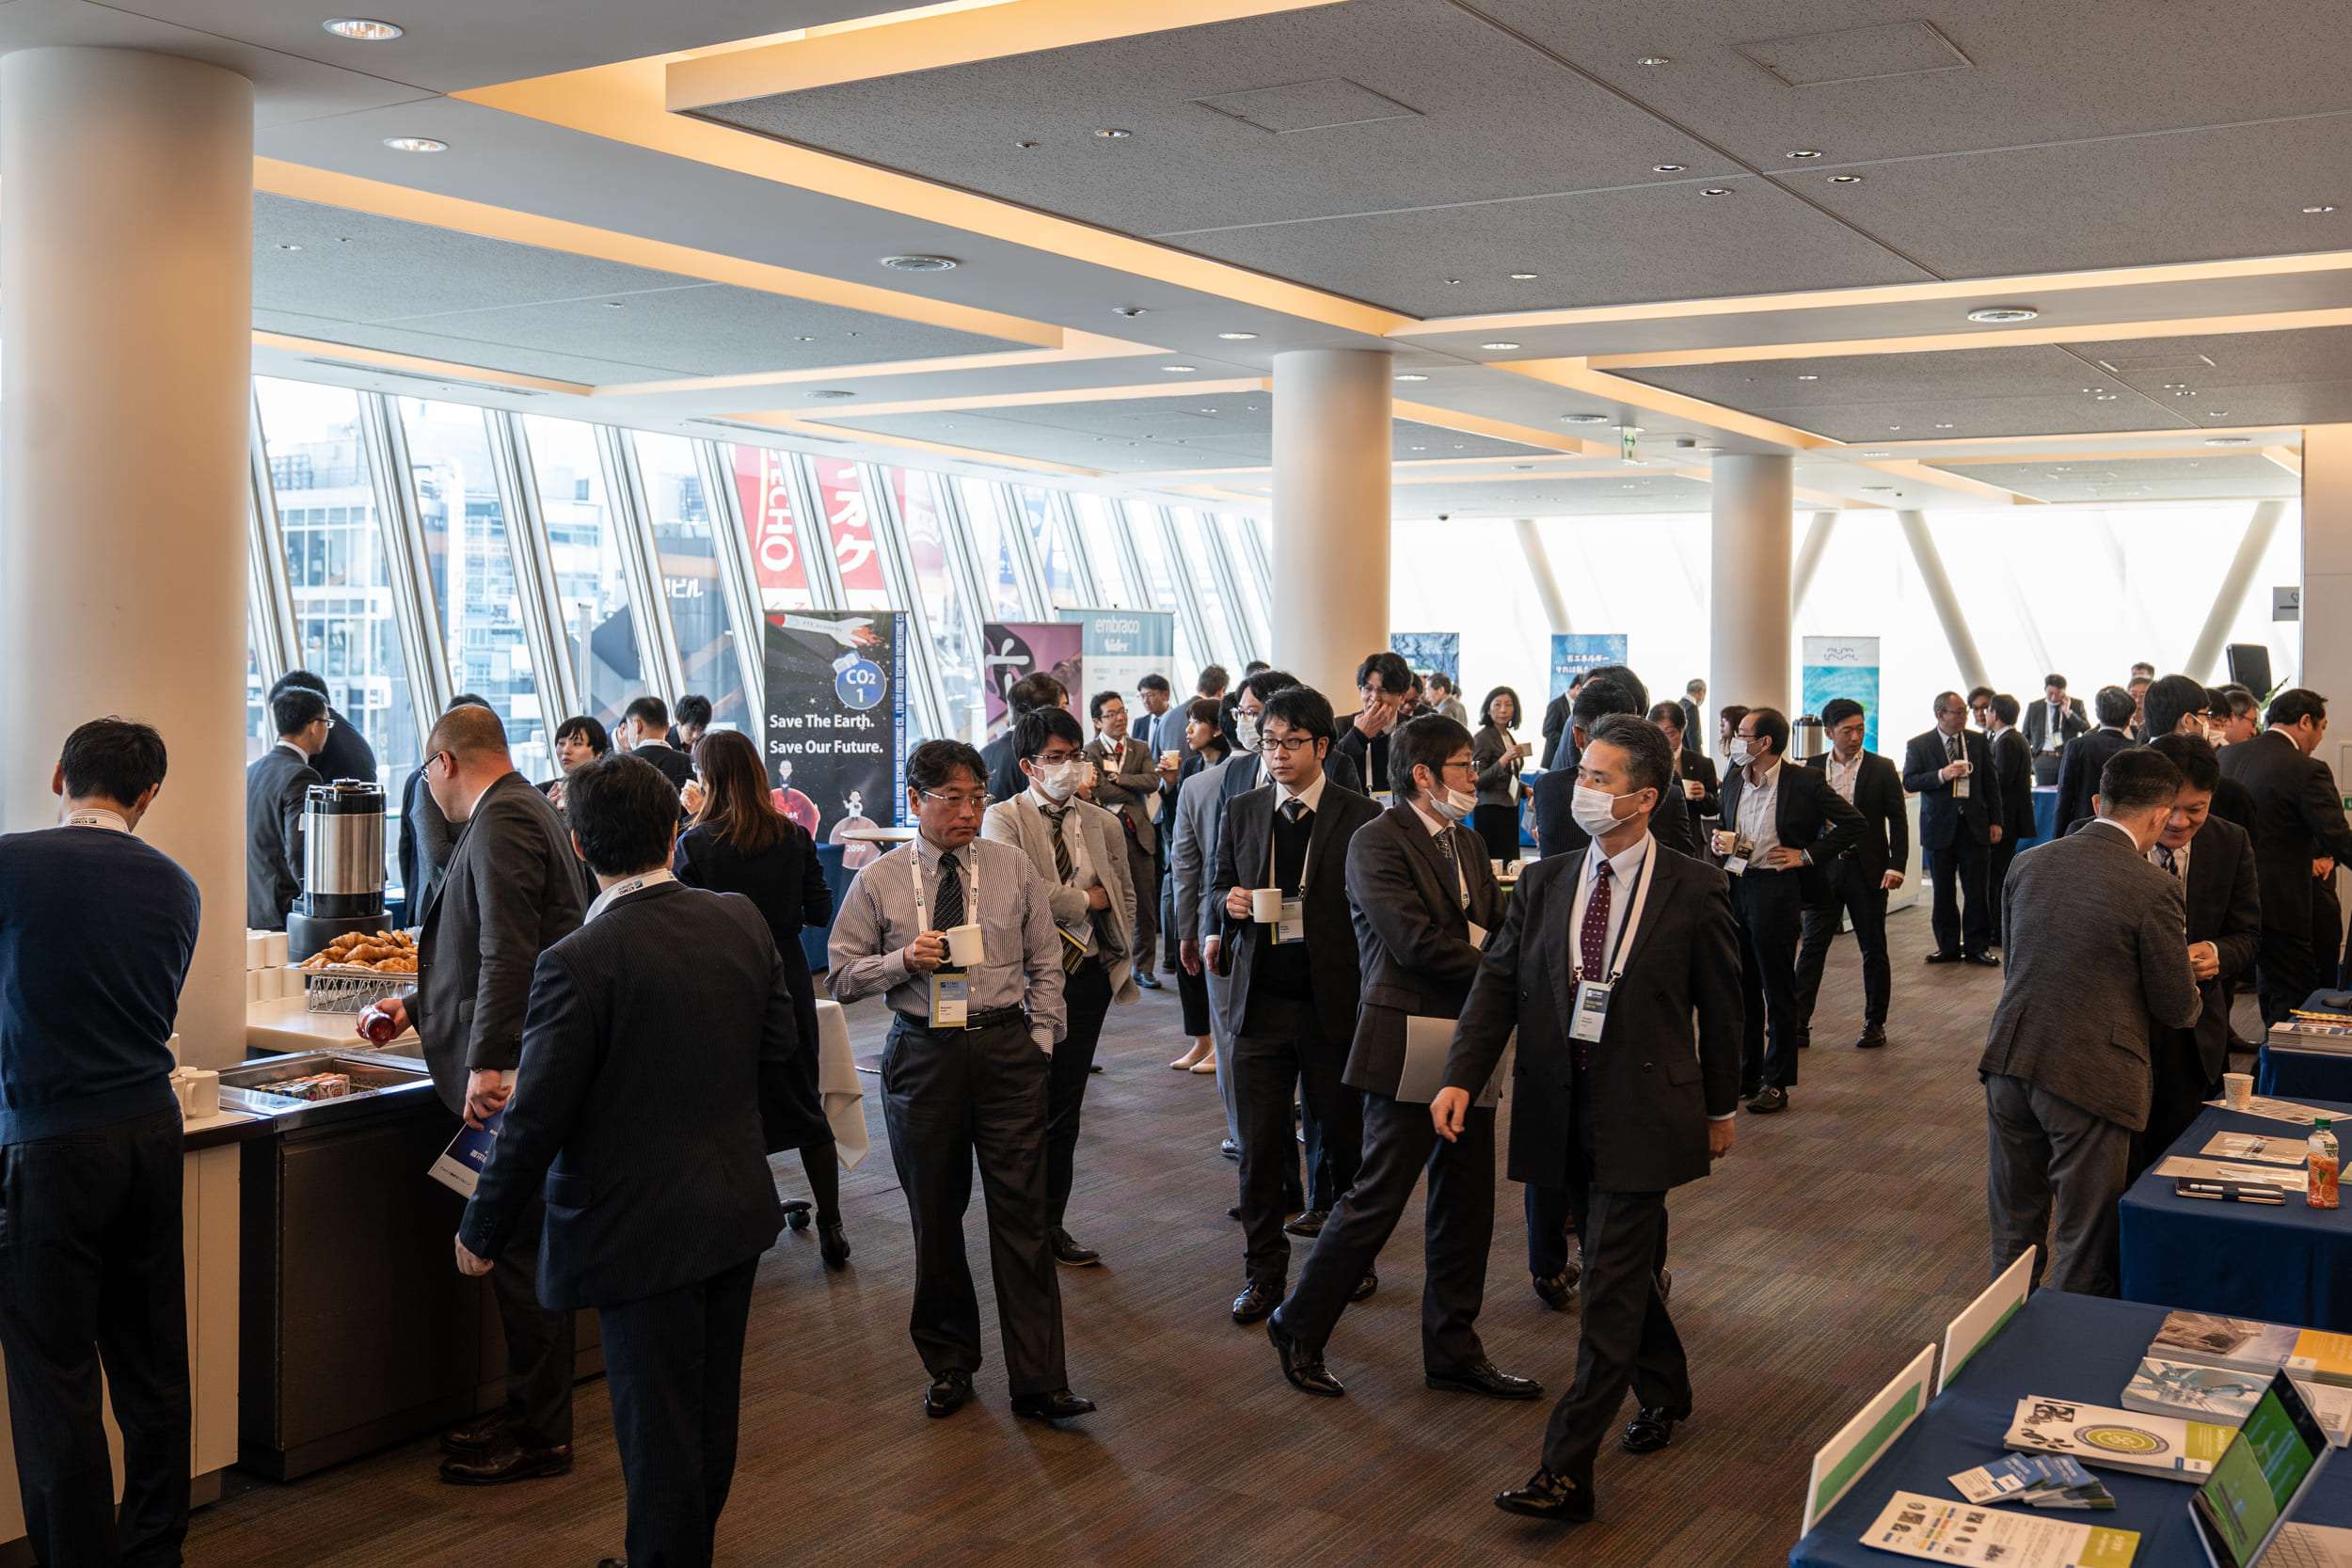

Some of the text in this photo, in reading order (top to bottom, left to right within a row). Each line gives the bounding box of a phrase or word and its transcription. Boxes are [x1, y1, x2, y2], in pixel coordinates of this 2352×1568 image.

[856, 688, 864, 703] 1
[770, 714, 875, 728] Save The Earth.
[770, 739, 884, 753] Save Our Future.
[846, 844, 866, 852] 2090
